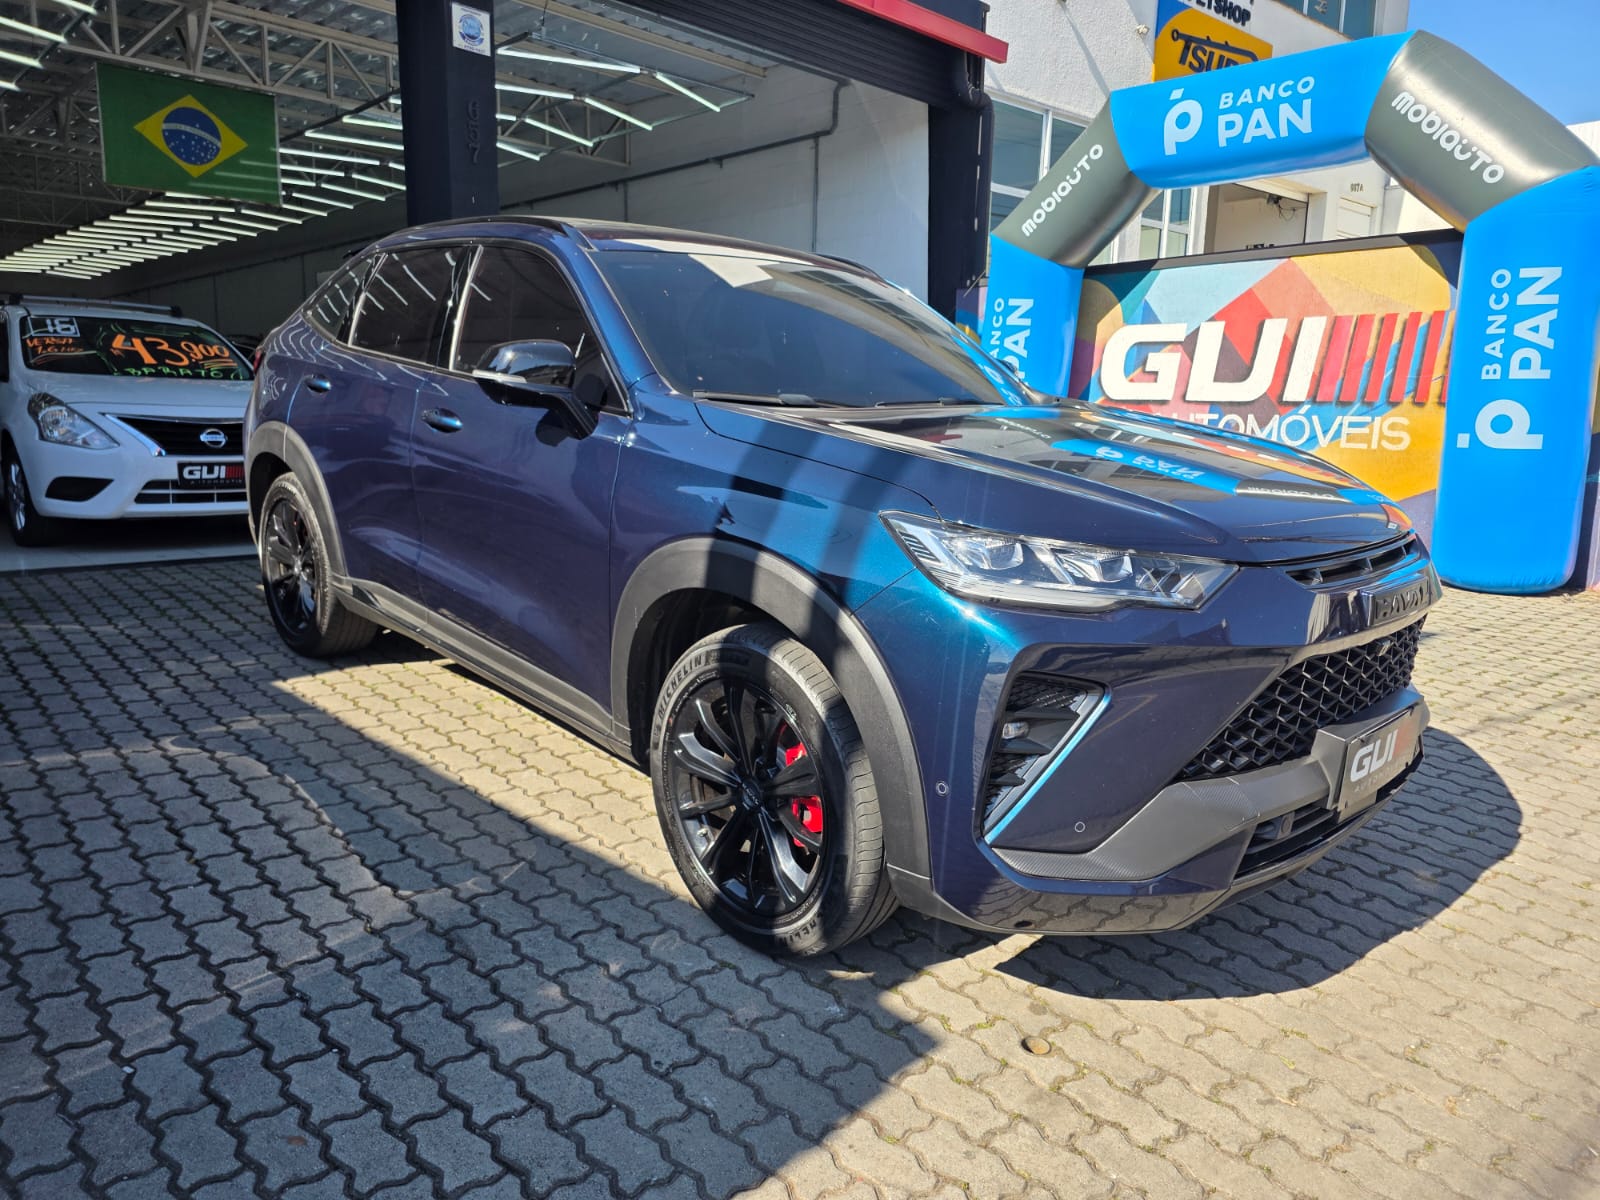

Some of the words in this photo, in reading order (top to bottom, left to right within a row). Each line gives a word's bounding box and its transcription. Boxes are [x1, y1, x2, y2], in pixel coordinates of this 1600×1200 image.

[1219, 76, 1315, 109] BANCO
[1218, 98, 1313, 147] PAN
[989, 298, 1005, 359] ANCO
[1481, 268, 1512, 380] BANCO
[1508, 266, 1563, 380] PAN
[1100, 317, 1326, 402] GUI
[1153, 404, 1411, 451] TOMÓVEIS
[183, 465, 227, 480] GUI
[658, 654, 703, 719] MICHELIN
[1350, 729, 1399, 783] GUI
